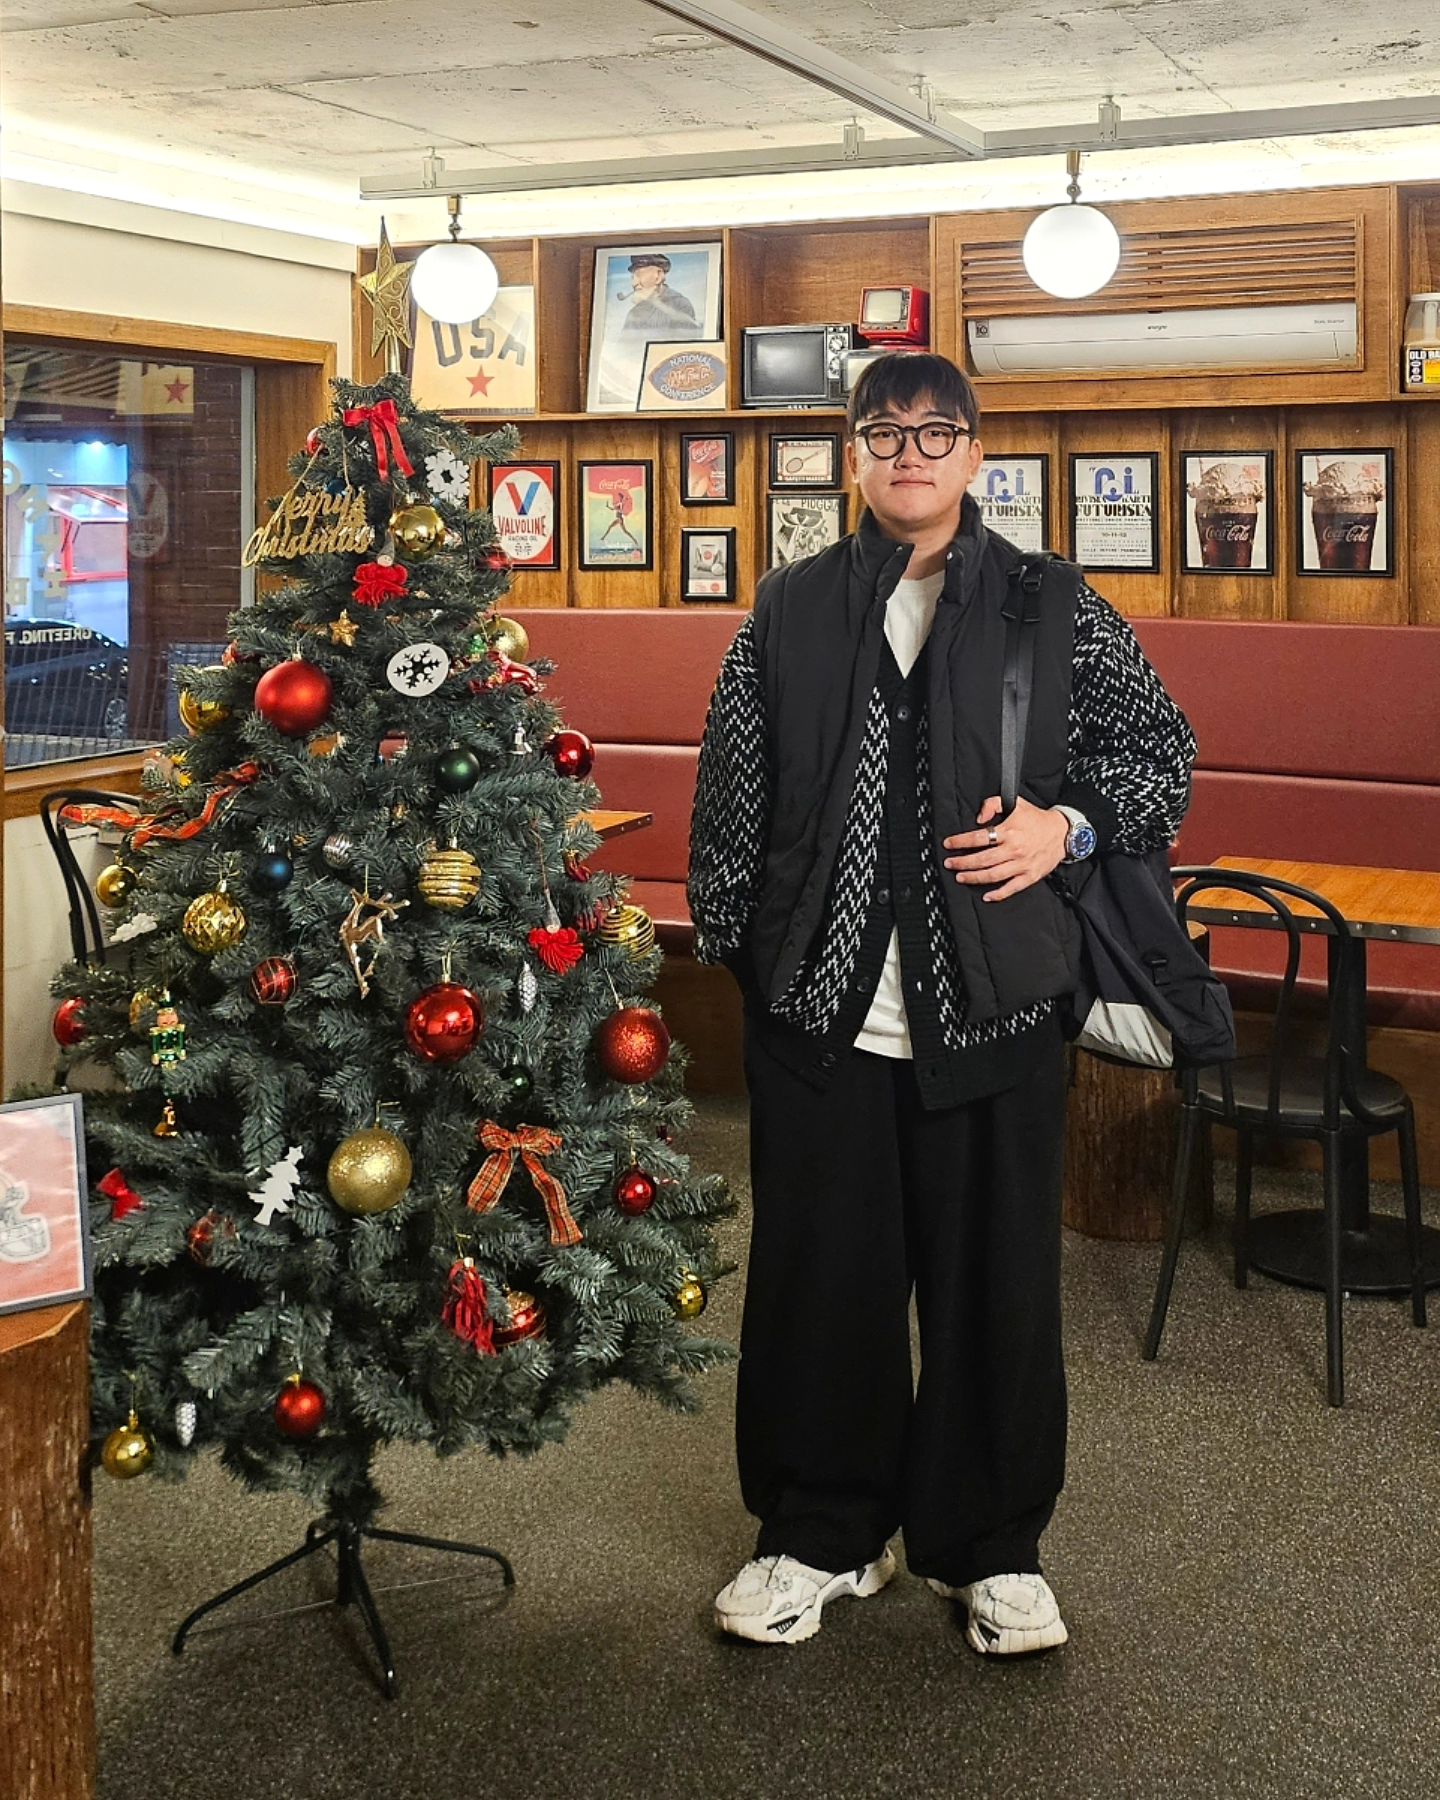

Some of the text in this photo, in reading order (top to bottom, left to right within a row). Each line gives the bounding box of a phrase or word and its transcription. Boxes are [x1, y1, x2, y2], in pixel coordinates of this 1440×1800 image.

[431, 311, 529, 367] USA
[669, 354, 713, 368] NATIONAL
[1410, 351, 1426, 360] OLD
[268, 484, 354, 530] Merry
[498, 515, 546, 536] VALVOLINE
[1206, 524, 1250, 541] Coca-Cola
[1323, 524, 1371, 542] Coca-Cola
[241, 526, 375, 567] Christmas
